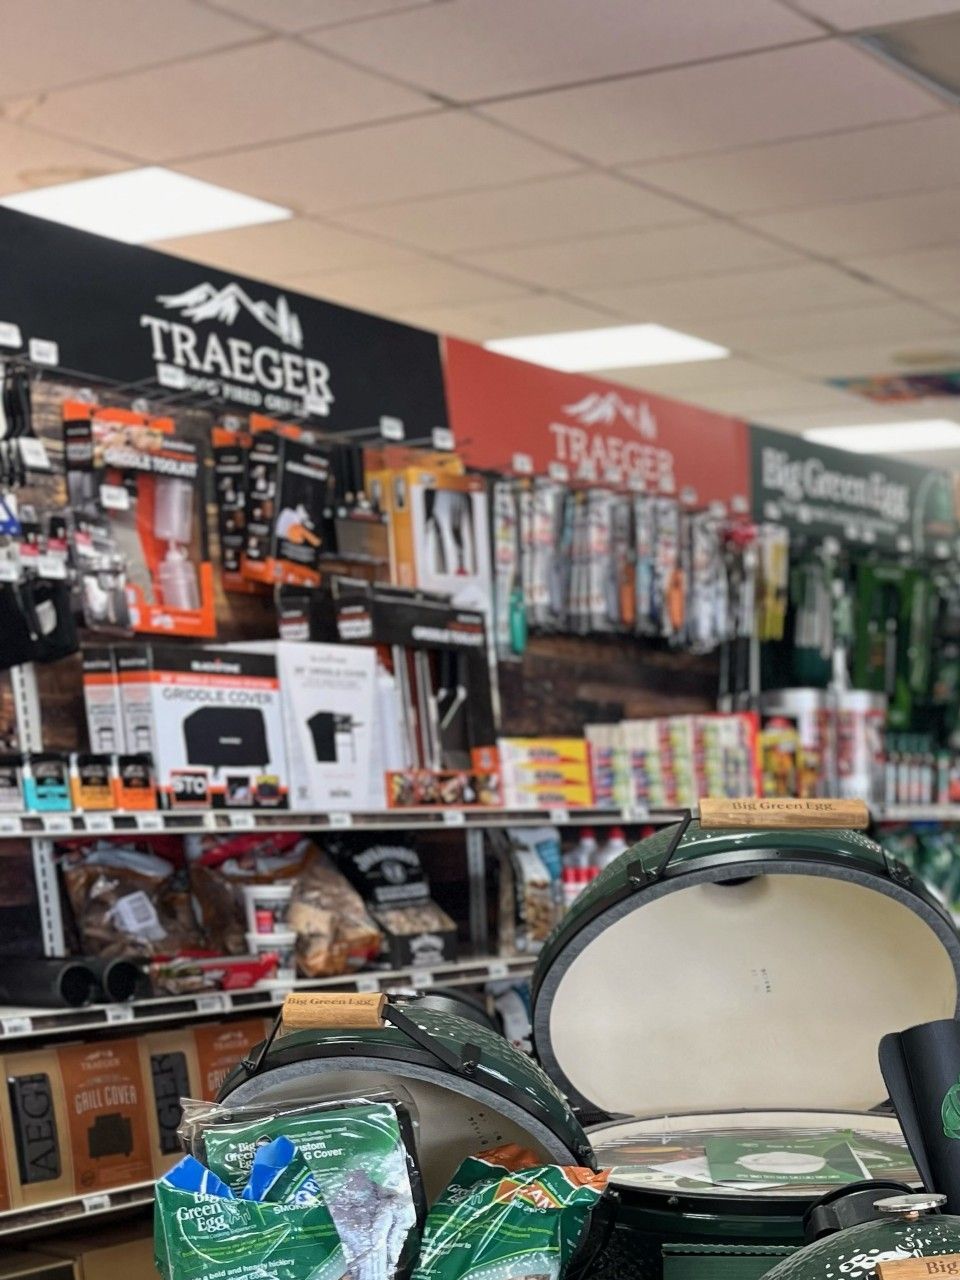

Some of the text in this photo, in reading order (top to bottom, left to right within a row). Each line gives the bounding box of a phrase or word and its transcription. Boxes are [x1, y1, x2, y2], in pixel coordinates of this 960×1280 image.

[140, 314, 334, 404] TRAEGER
[550, 423, 676, 484] TRAEGER
[762, 447, 802, 500] Big
[803, 456, 866, 510] Green
[163, 687, 273, 705] GRIDDLE COVER
[732, 802, 757, 812] Big
[759, 802, 803, 810] Green
[288, 997, 307, 1006] Big
[75, 1085, 138, 1114] GRILL COVER
[176, 1202, 222, 1222] Green
[197, 1215, 228, 1233] Egg
[926, 1260, 958, 1275] Big
